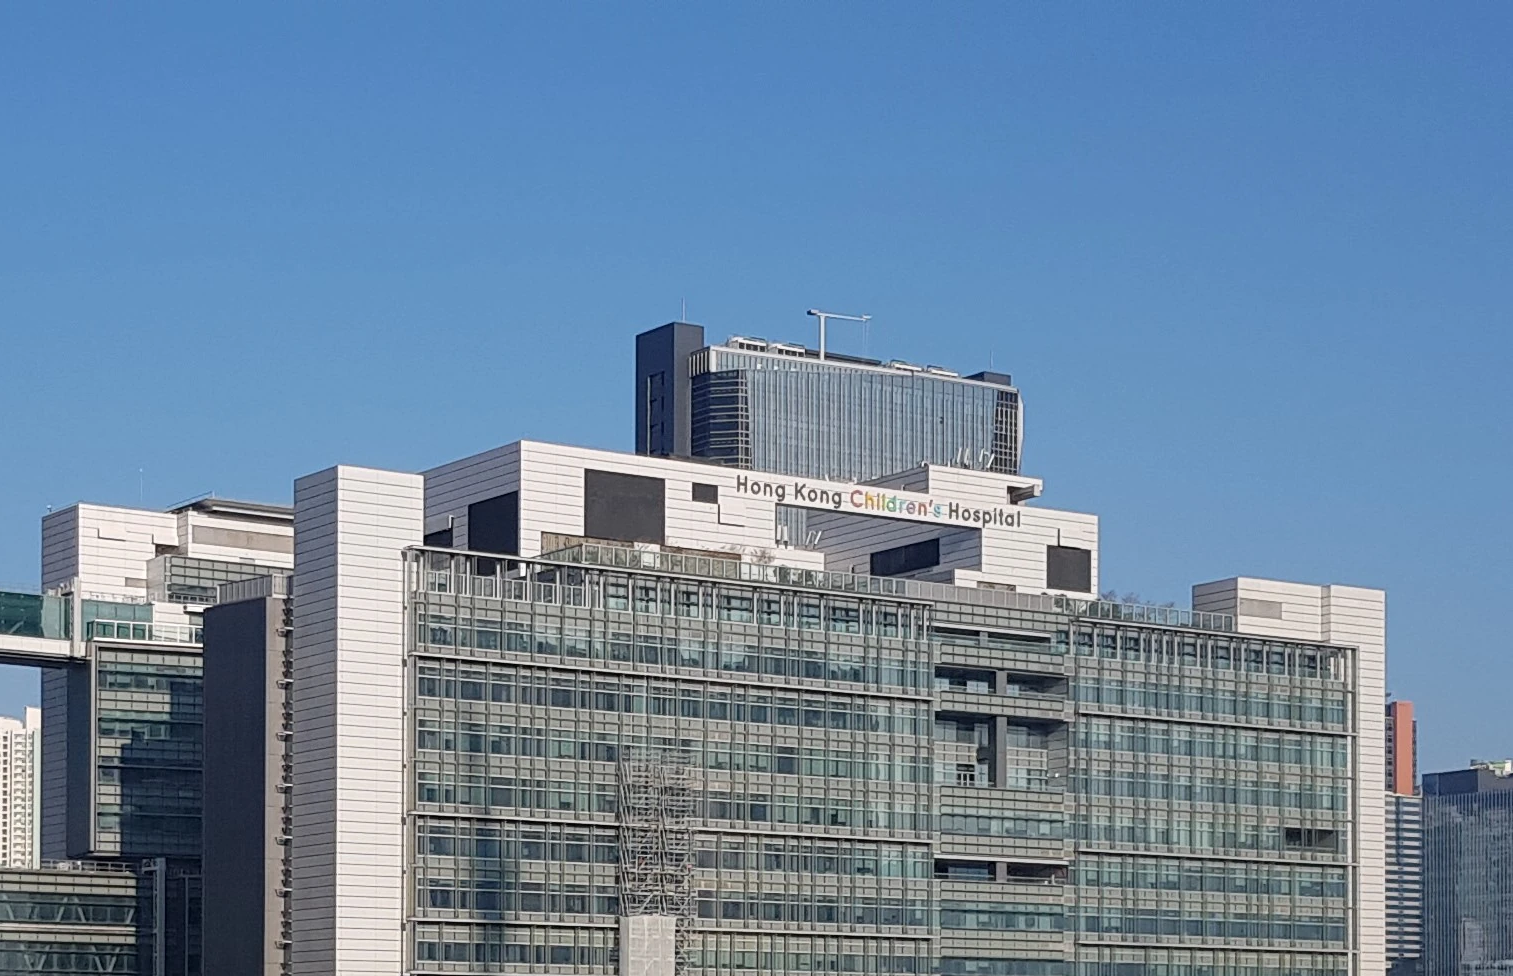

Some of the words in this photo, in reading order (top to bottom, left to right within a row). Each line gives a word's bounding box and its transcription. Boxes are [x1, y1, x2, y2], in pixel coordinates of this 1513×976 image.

[736, 475, 786, 501] Hong
[794, 483, 842, 508] Kong
[850, 489, 941, 518] Children's
[948, 502, 1021, 528] Hospital
